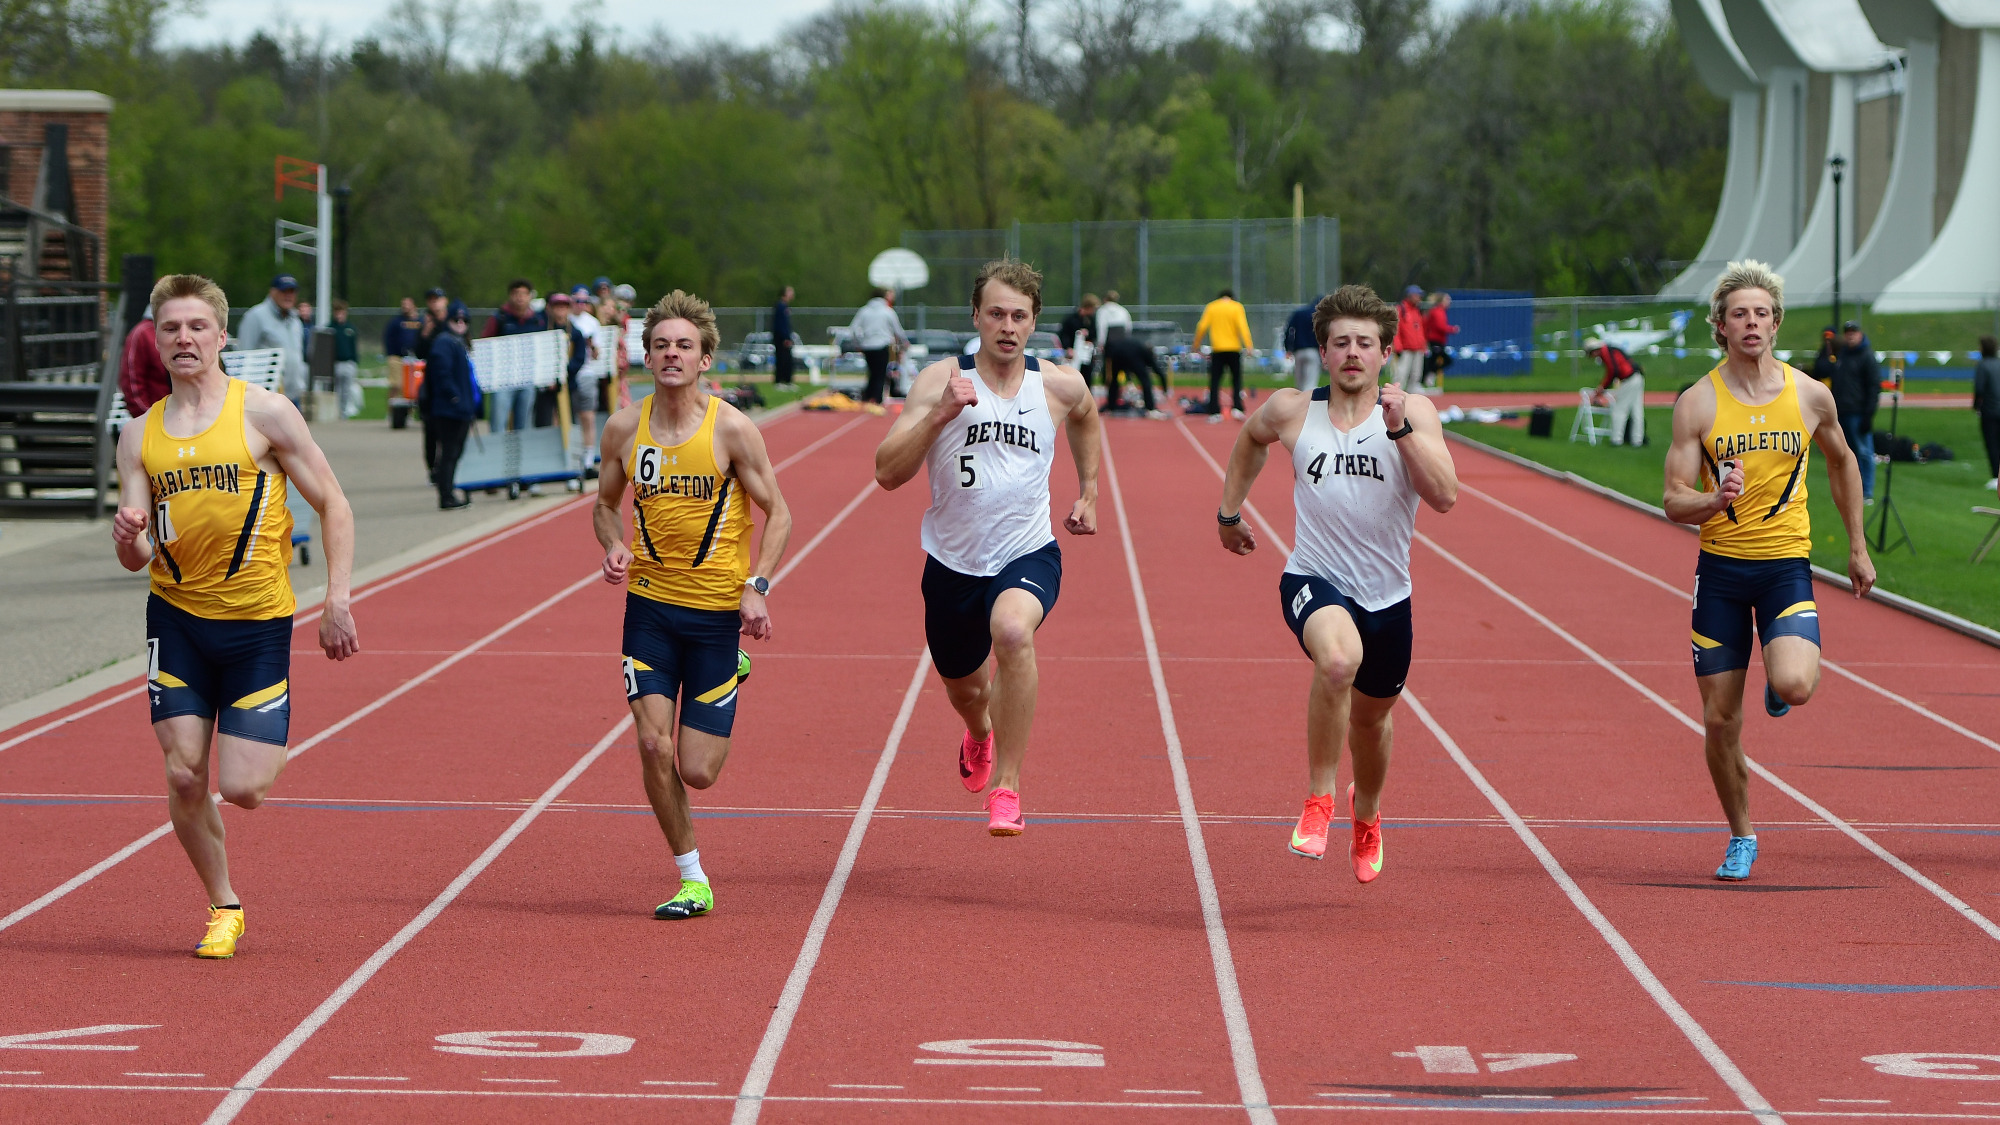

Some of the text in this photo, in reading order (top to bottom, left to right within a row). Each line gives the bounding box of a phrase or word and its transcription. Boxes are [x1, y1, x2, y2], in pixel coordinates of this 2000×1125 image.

[964, 421, 1040, 455] BETHEL
[1715, 431, 1801, 461] CARLETON
[640, 447, 655, 482] 6
[960, 454, 976, 488] 5
[1306, 451, 1327, 485] 4
[158, 503, 168, 541] 7
[431, 1030, 637, 1058] 6
[913, 1038, 1106, 1067] 5
[1391, 1045, 1579, 1074] 4
